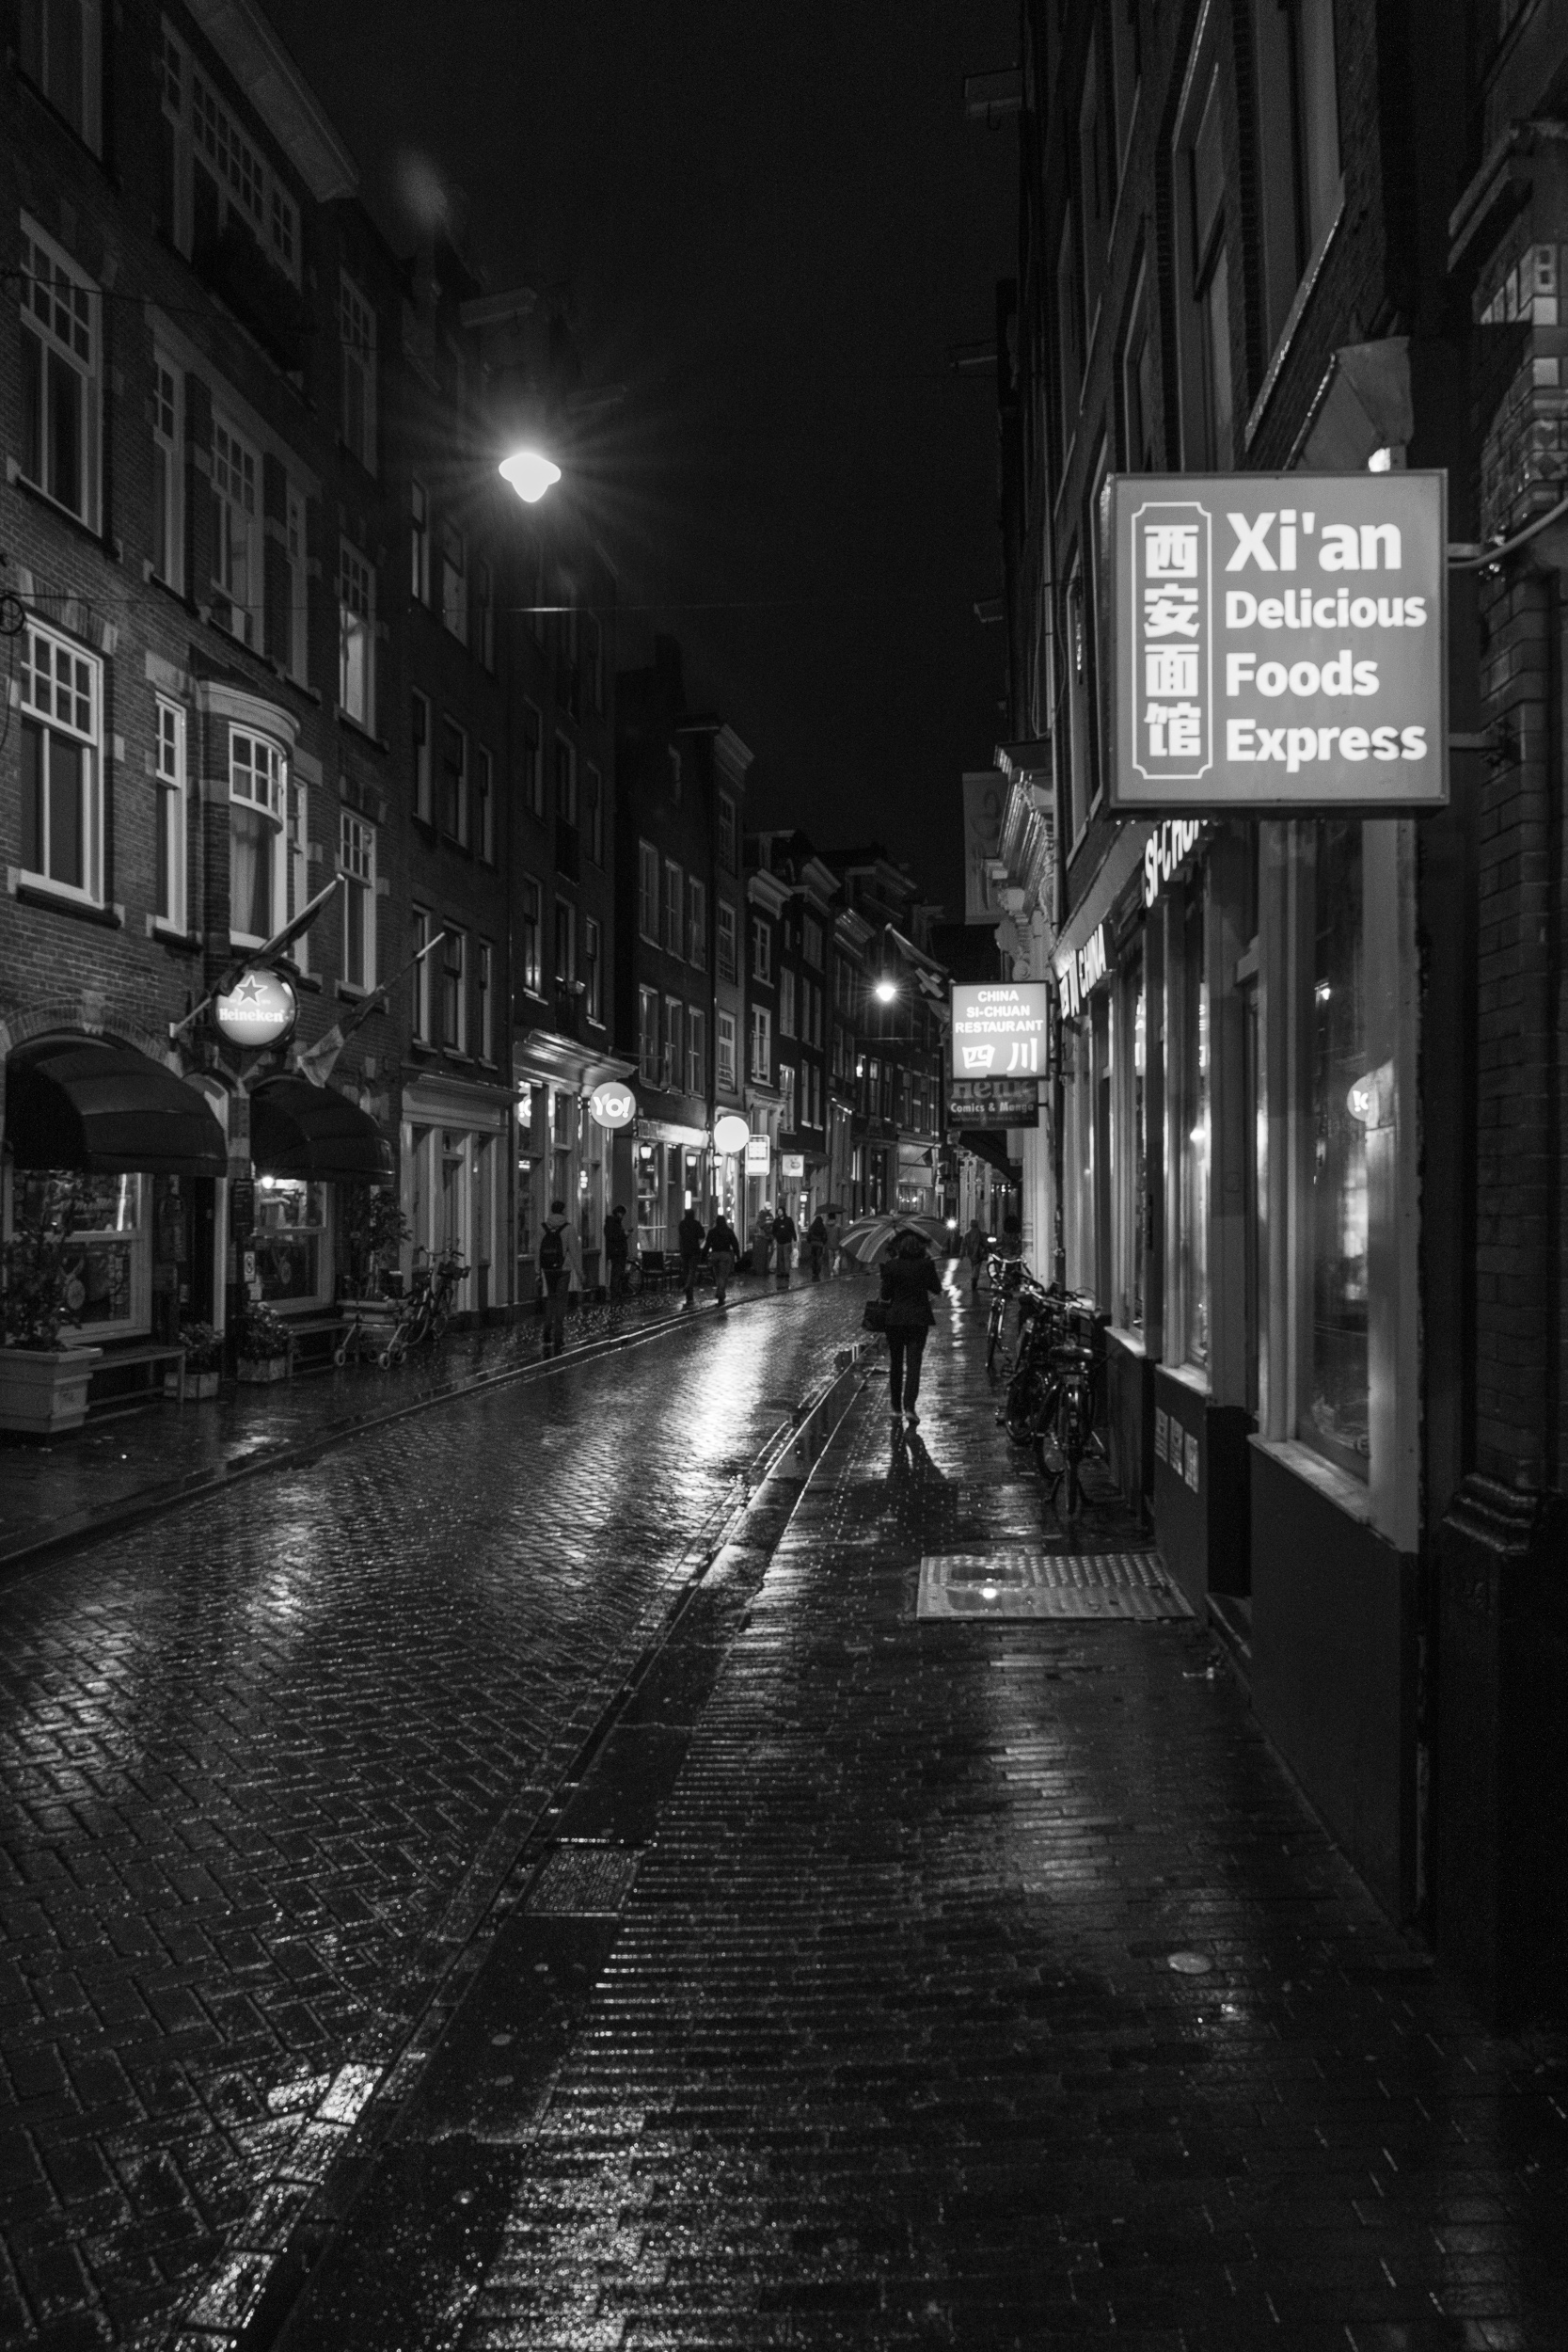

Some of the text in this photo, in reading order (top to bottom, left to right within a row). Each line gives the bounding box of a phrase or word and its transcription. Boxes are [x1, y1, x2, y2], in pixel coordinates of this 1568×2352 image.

[1225, 509, 1402, 572] Xi'an
[1226, 587, 1428, 629] Delicious
[1144, 525, 1201, 757] 西安面馆
[1226, 649, 1380, 698] Foods
[1227, 718, 1428, 773] Express
[977, 990, 1019, 1003] CHINA
[219, 1008, 285, 1023] Heineken
[966, 1005, 1030, 1019] SI-CHUAN
[955, 1020, 1044, 1034] RESTAURANT
[950, 1102, 1034, 1113] Comics & Manga
